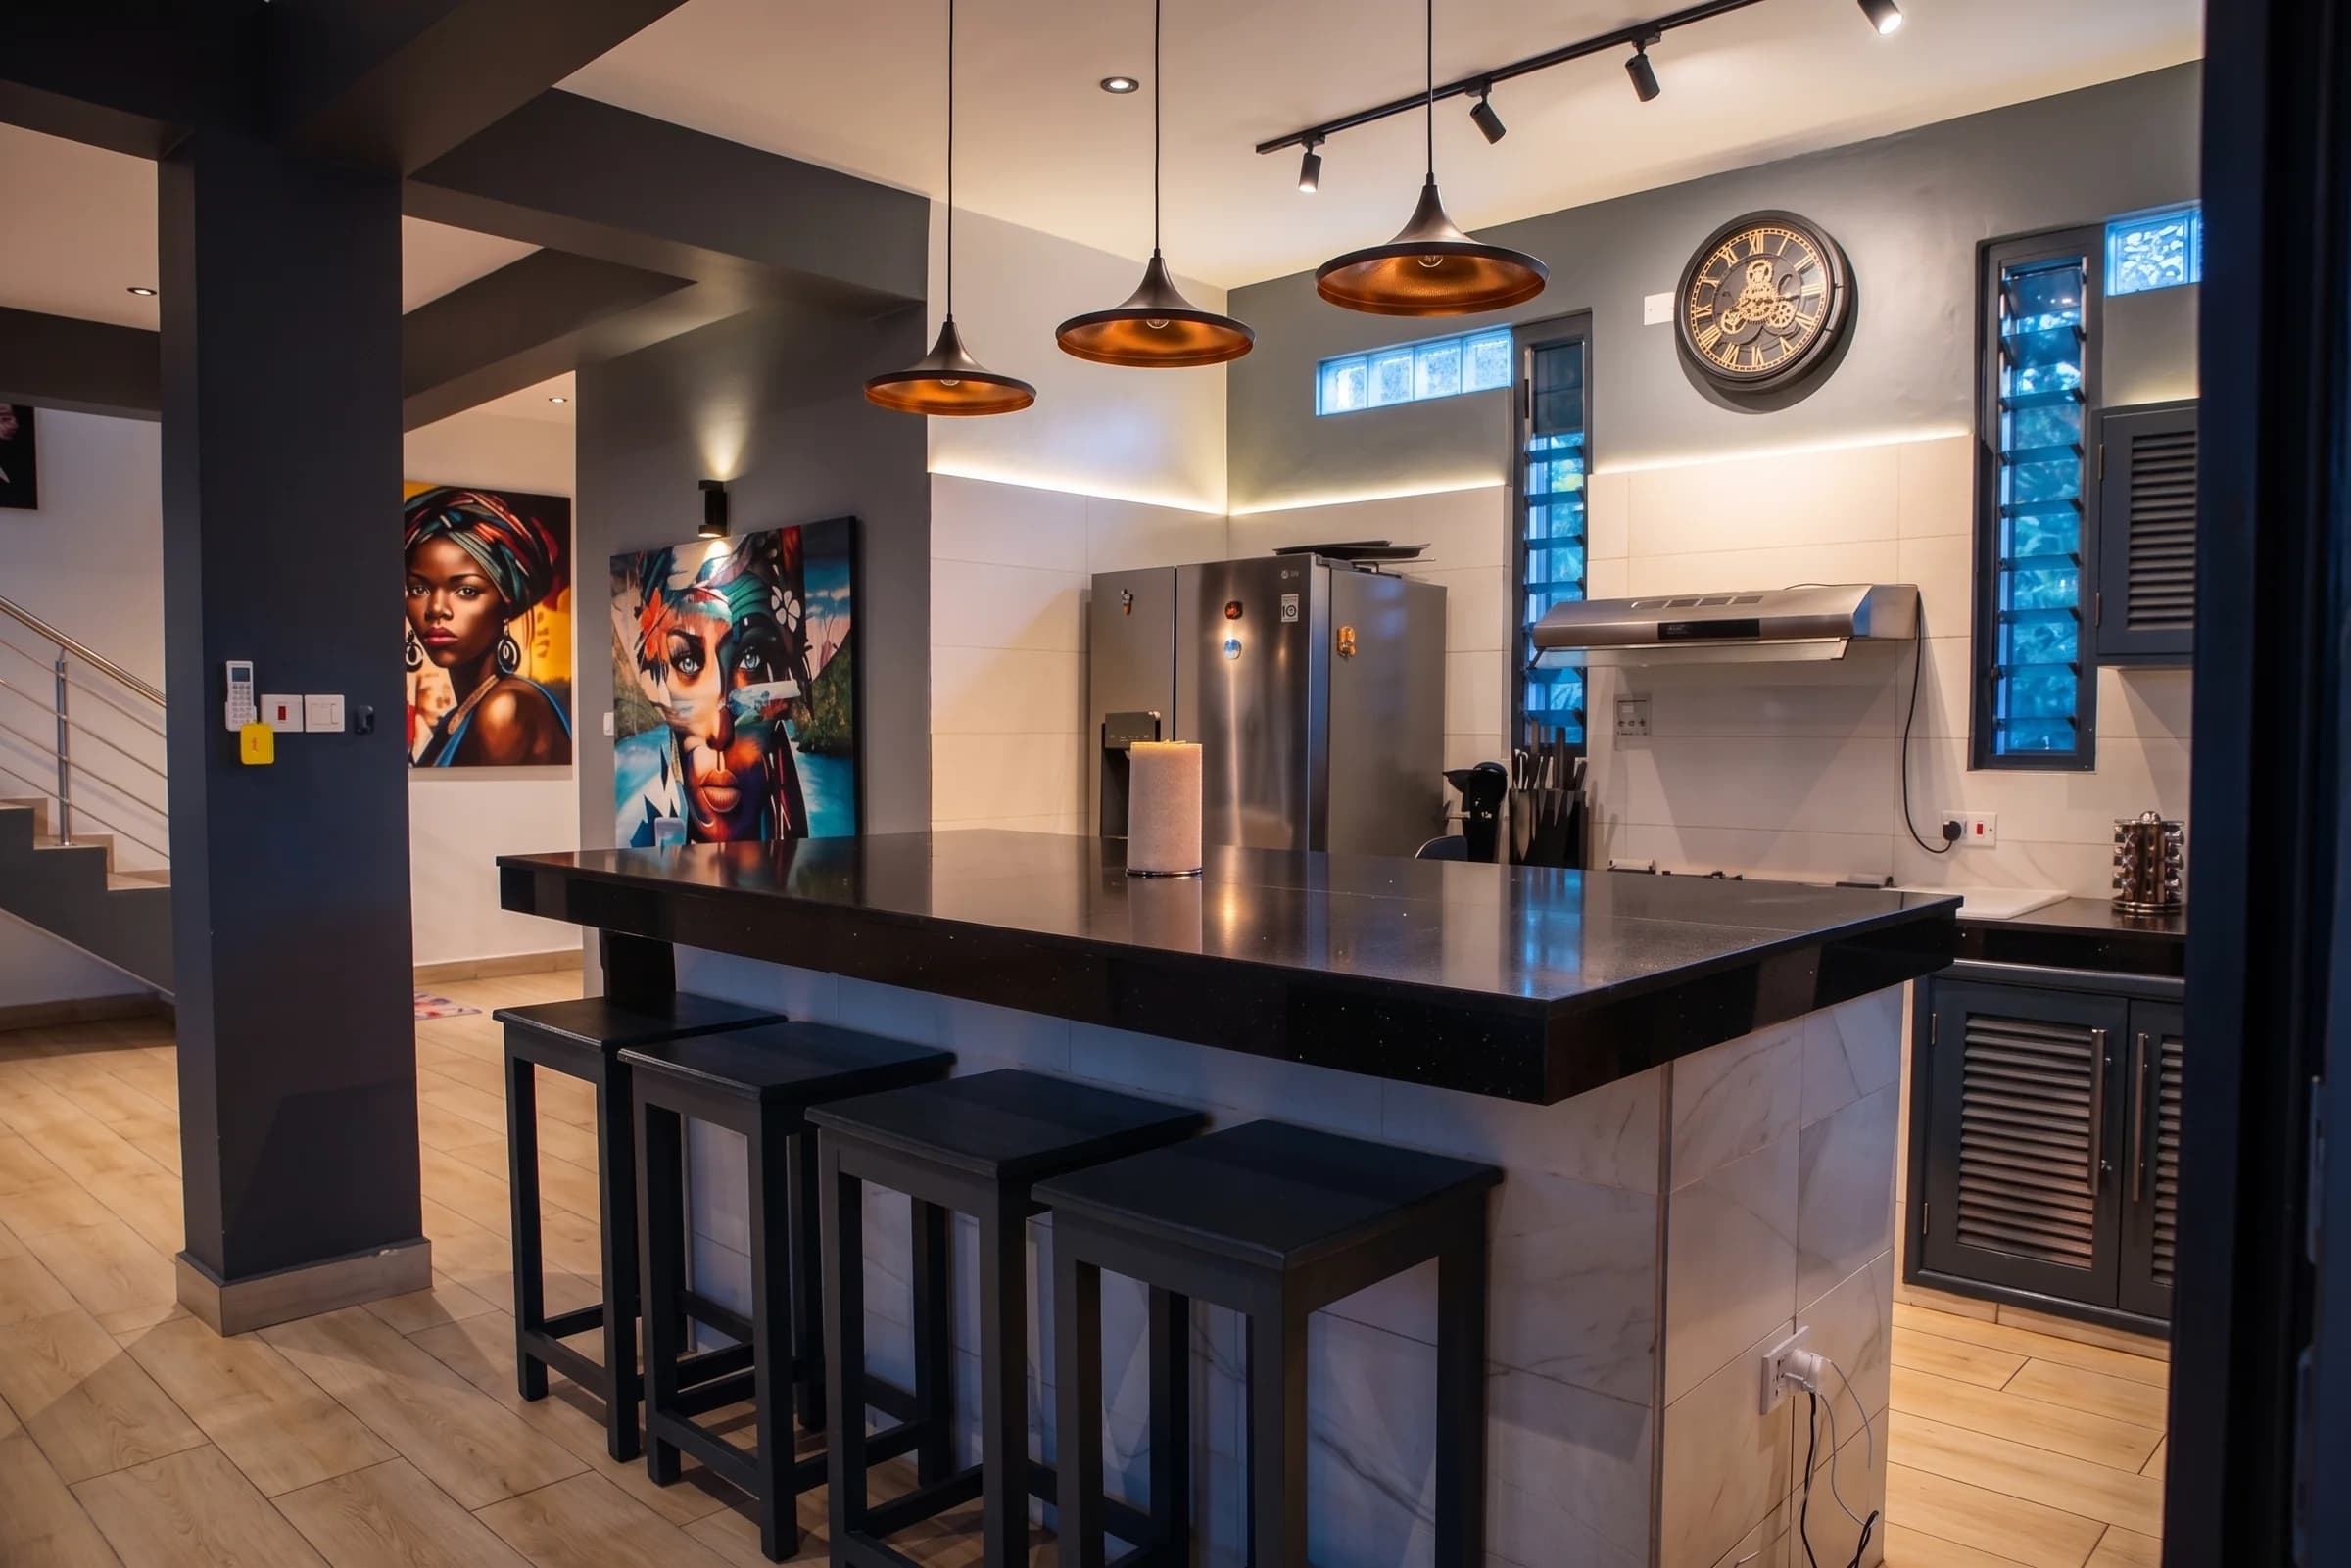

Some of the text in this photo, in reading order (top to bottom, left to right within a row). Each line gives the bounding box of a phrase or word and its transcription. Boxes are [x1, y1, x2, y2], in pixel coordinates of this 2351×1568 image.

[1749, 233, 1764, 256] XII
[1777, 235, 1790, 256] I
[1795, 254, 1815, 271] II
[1801, 284, 1822, 296] III
[1779, 336, 1794, 356] V
